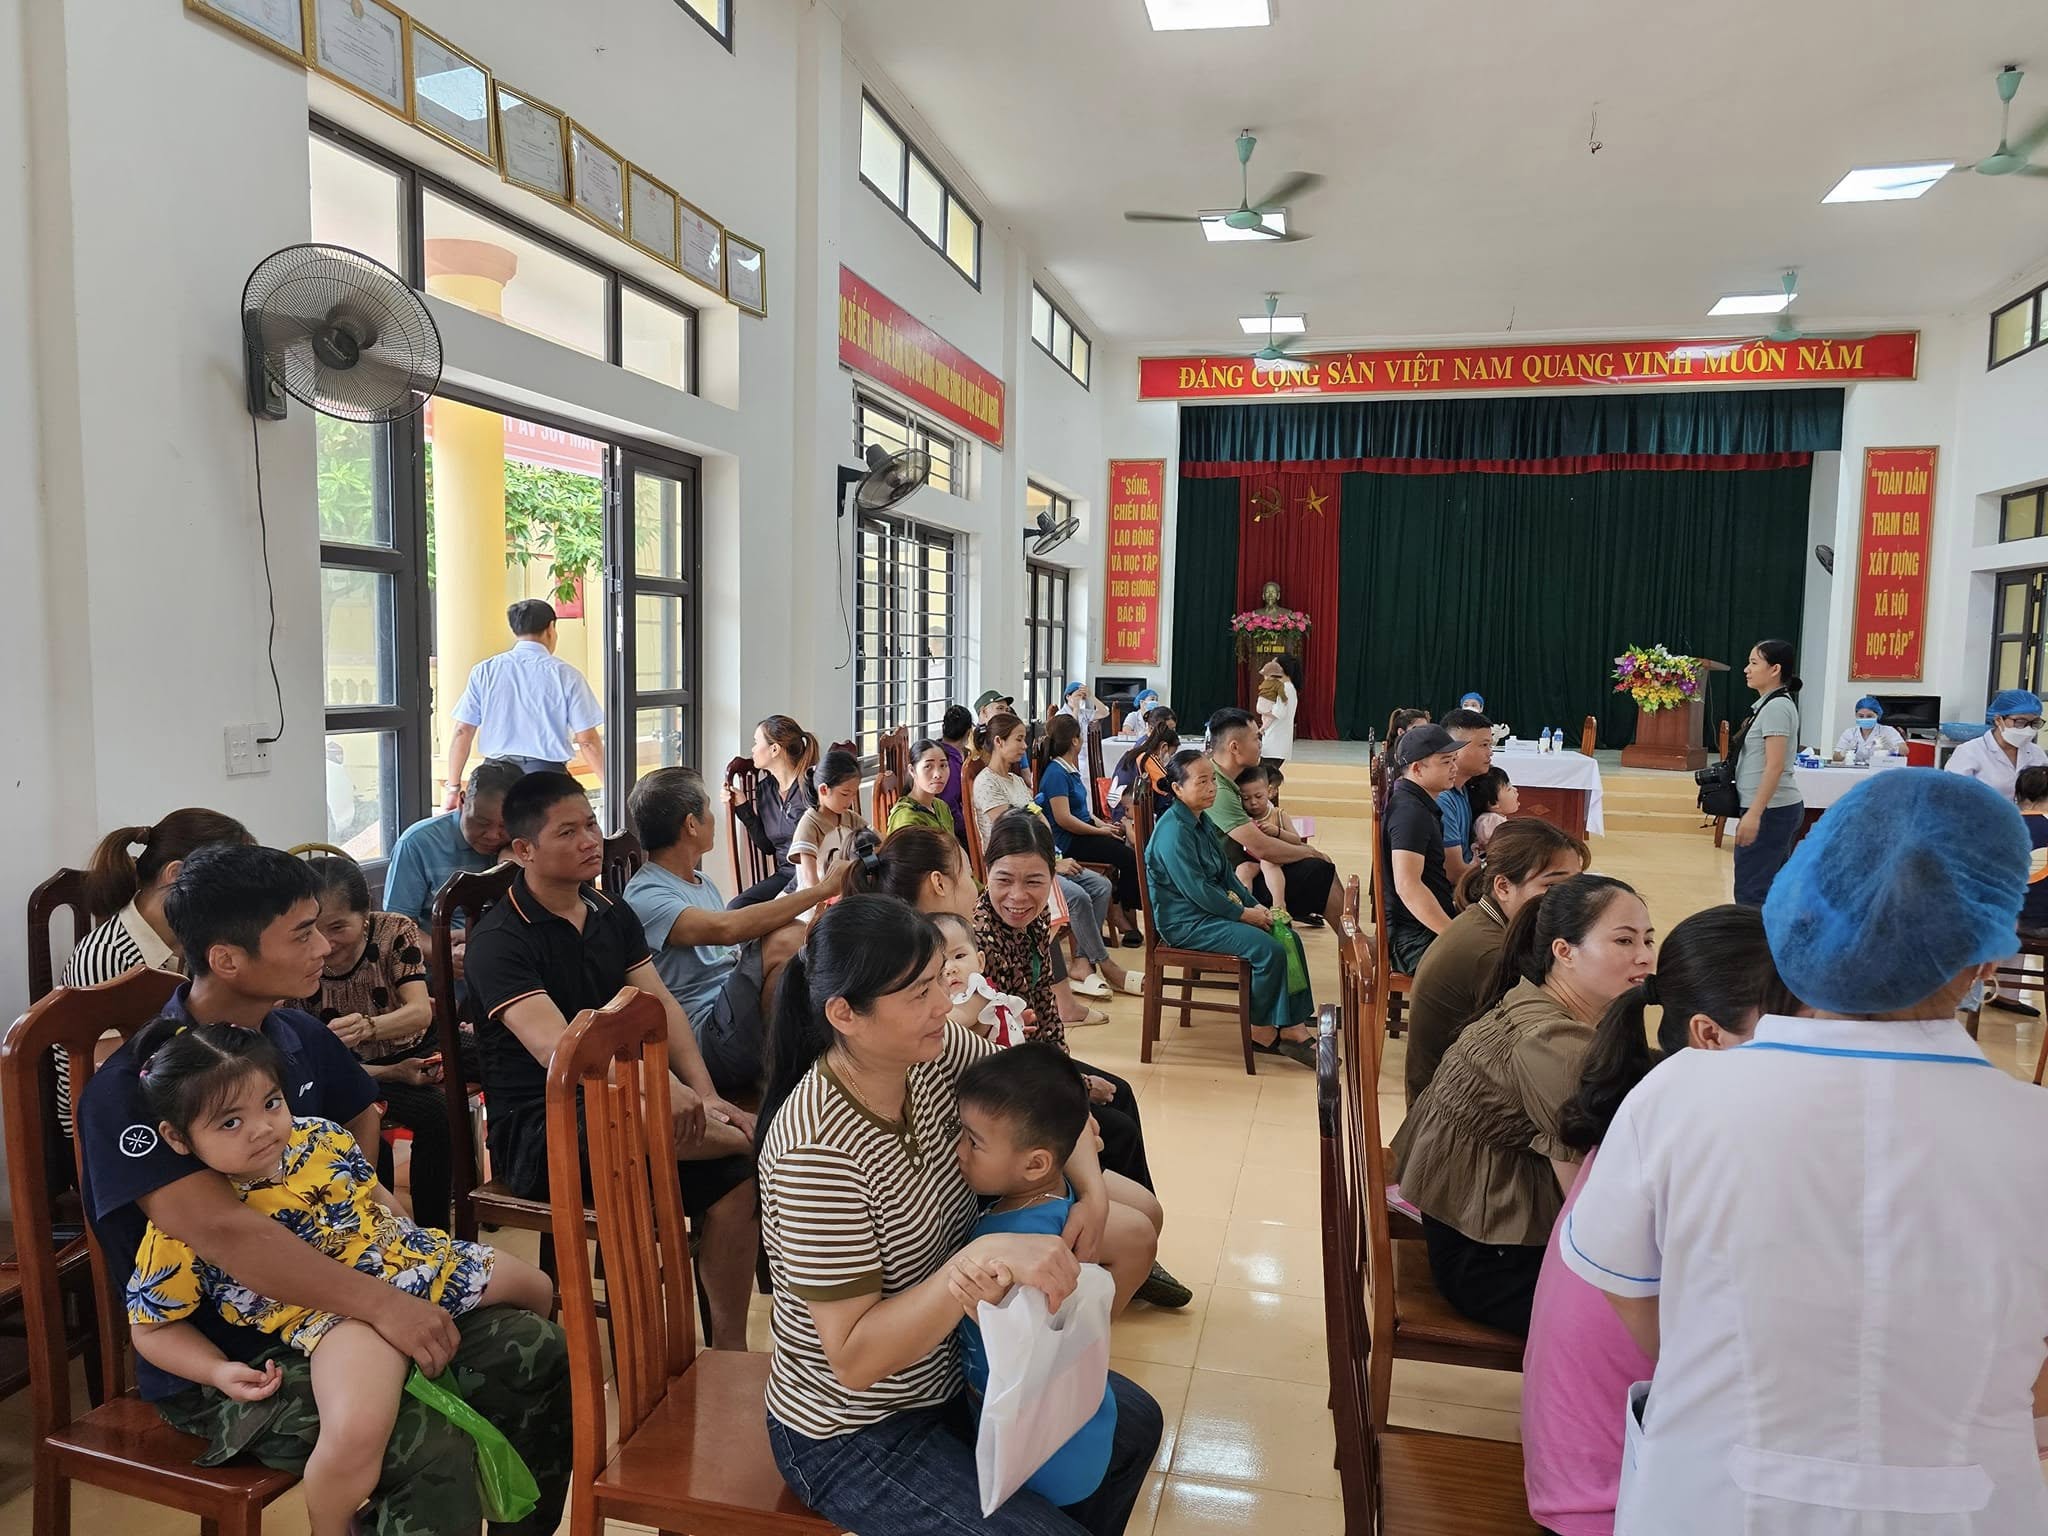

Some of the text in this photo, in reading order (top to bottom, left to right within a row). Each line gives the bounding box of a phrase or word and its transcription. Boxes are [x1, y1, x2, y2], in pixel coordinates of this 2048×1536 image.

[1178, 340, 1865, 392] ĐẢNG CỘNG SẢN VIỆT NAM QUANG VINH MUÔN NĂM
[1905, 467, 1927, 495] DÂN
[1114, 499, 1139, 521] CHIẾN
[1872, 512, 1920, 536] THAM GIA
[1114, 530, 1130, 546] LAO
[1111, 552, 1158, 574] VÀ HỌC TẬP
[1868, 548, 1919, 580] XÂY DỰNG
[1111, 581, 1129, 597] THEO
[1117, 601, 1147, 622] BÁC HỒ
[1891, 589, 1908, 620] HỘI
[1866, 632, 1887, 660] HỌC
